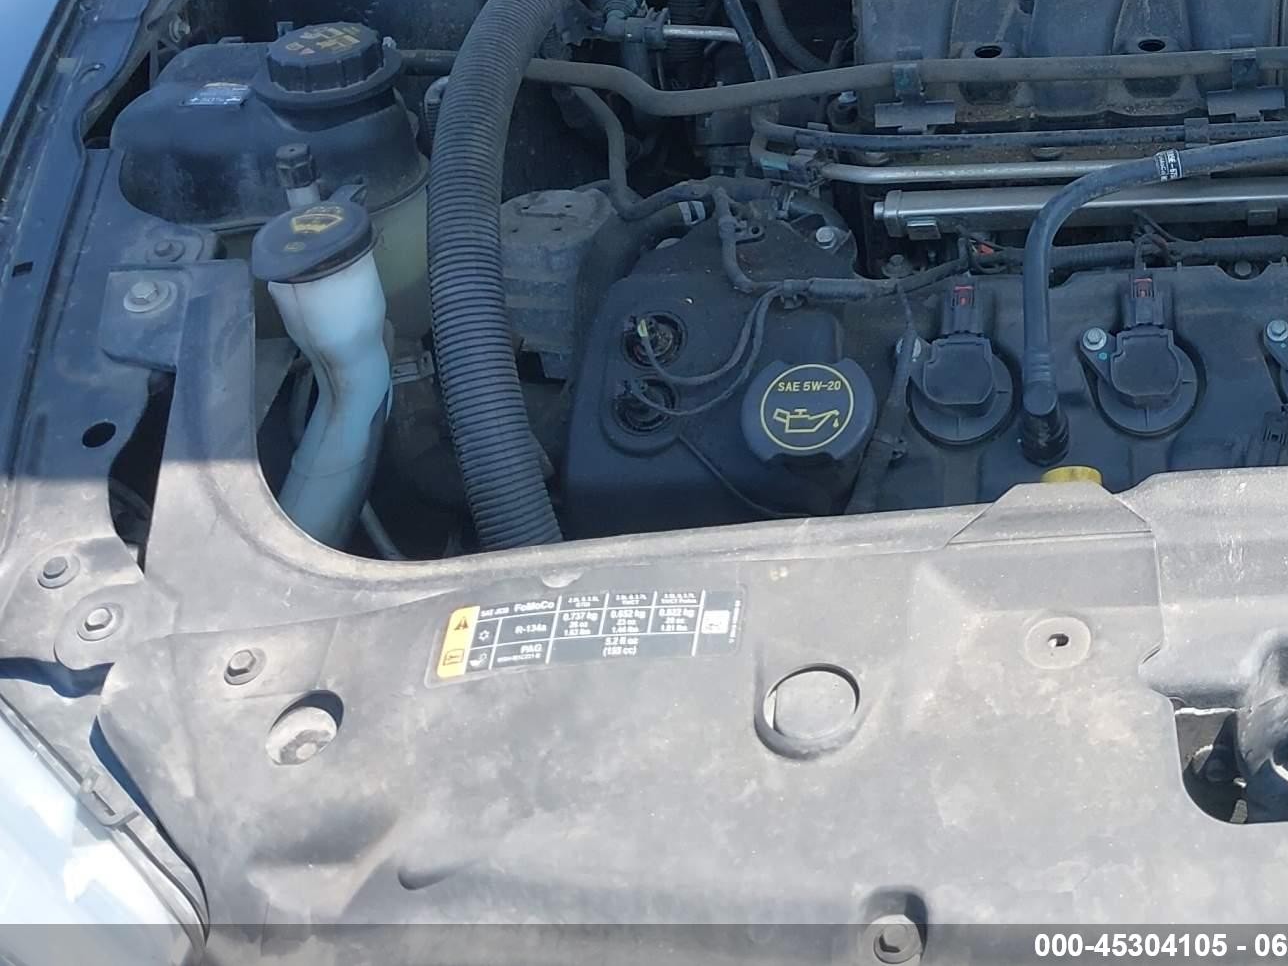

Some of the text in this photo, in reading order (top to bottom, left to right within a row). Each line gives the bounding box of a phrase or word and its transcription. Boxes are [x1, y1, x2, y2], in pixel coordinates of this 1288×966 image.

[778, 380, 841, 392] SAE 5W-20
[514, 600, 555, 612] FoMoCo
[514, 624, 547, 634] R-134a
[520, 643, 542, 654] PAG
